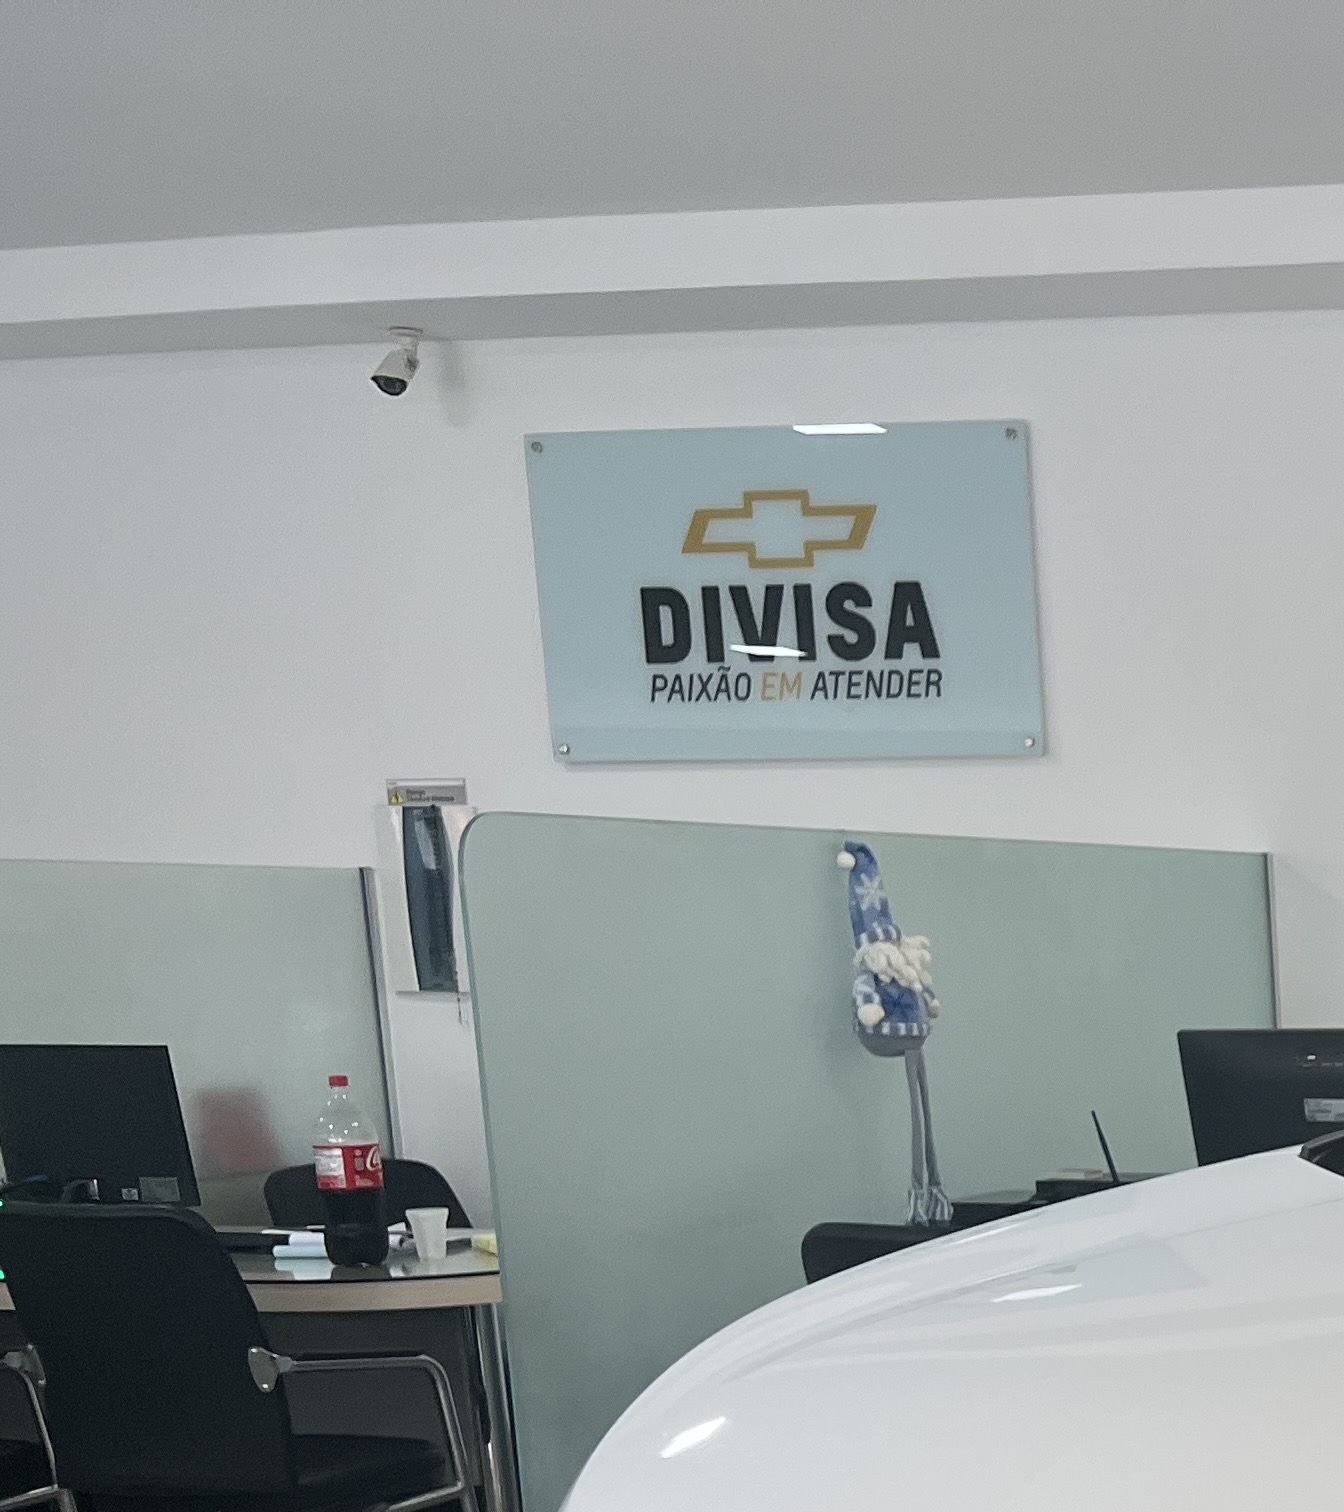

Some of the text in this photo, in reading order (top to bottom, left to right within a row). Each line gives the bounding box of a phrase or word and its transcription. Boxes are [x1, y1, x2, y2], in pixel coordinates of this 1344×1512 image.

[640, 580, 941, 665] DIVISA
[650, 665, 943, 703] PAIXÃO EM ATENDER
